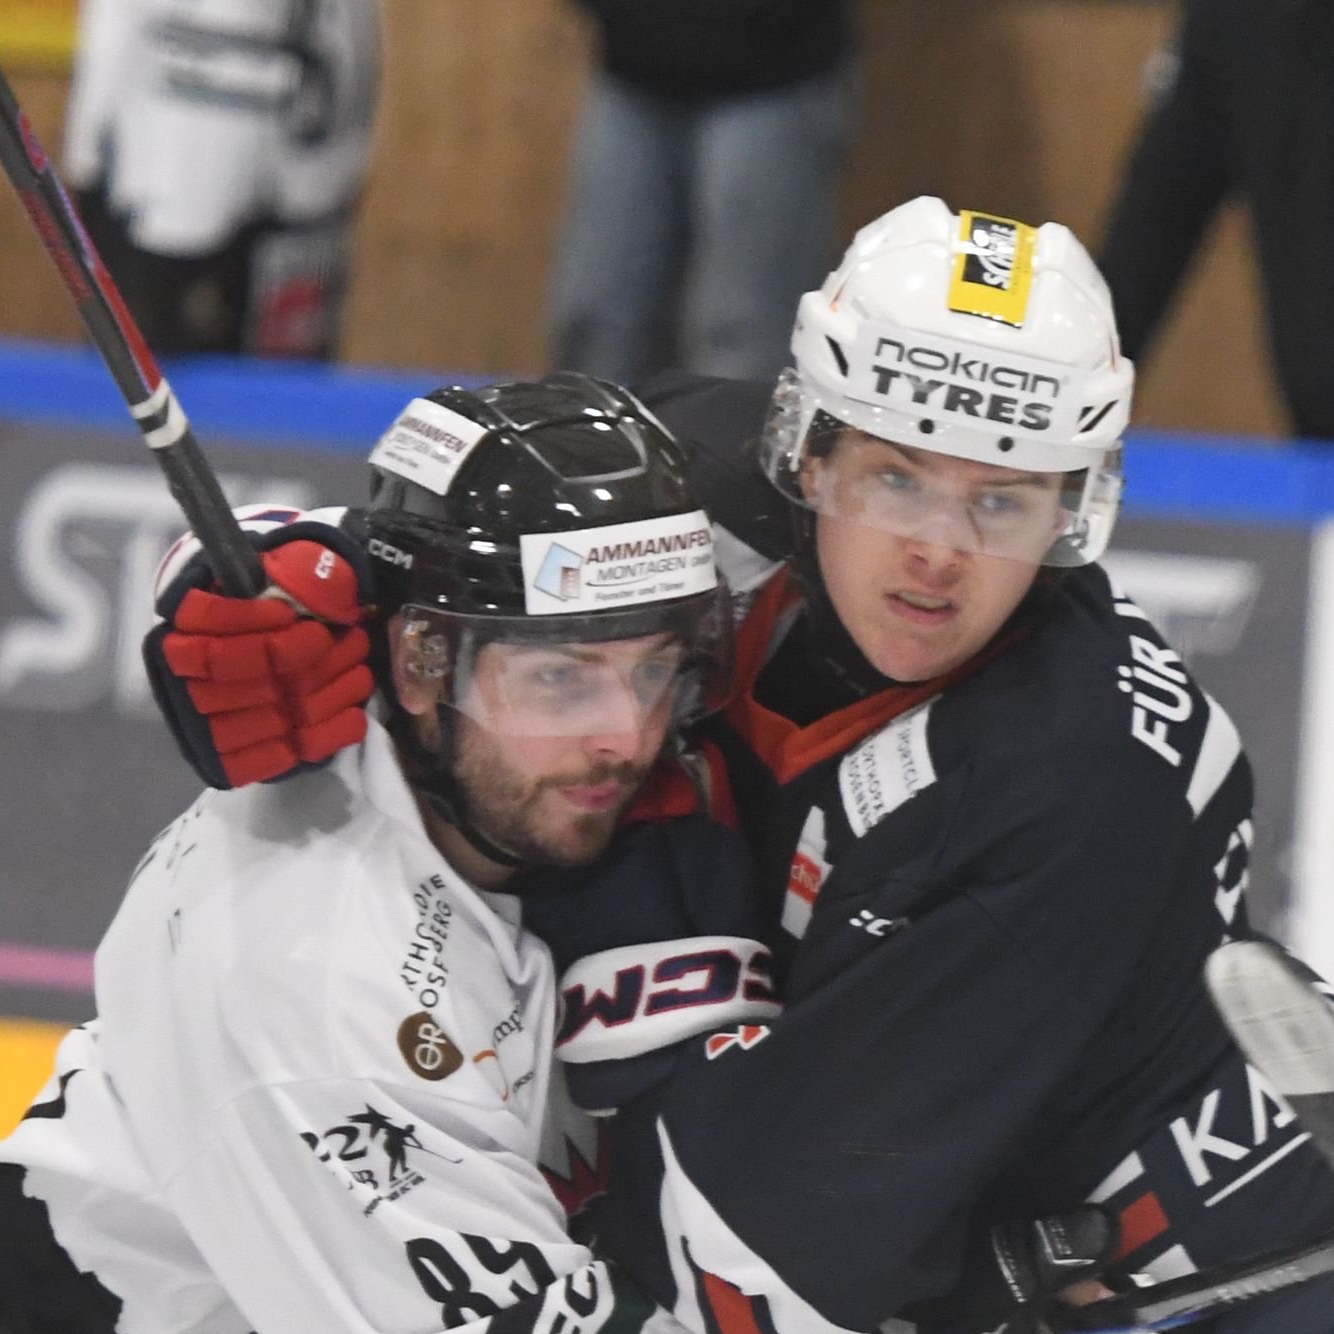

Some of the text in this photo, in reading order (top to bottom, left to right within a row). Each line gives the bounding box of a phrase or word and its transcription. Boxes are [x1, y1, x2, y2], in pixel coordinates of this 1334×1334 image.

[871, 364, 1055, 432] TYRES
[368, 537, 415, 571] CCM
[1116, 634, 1195, 767] FÜR
